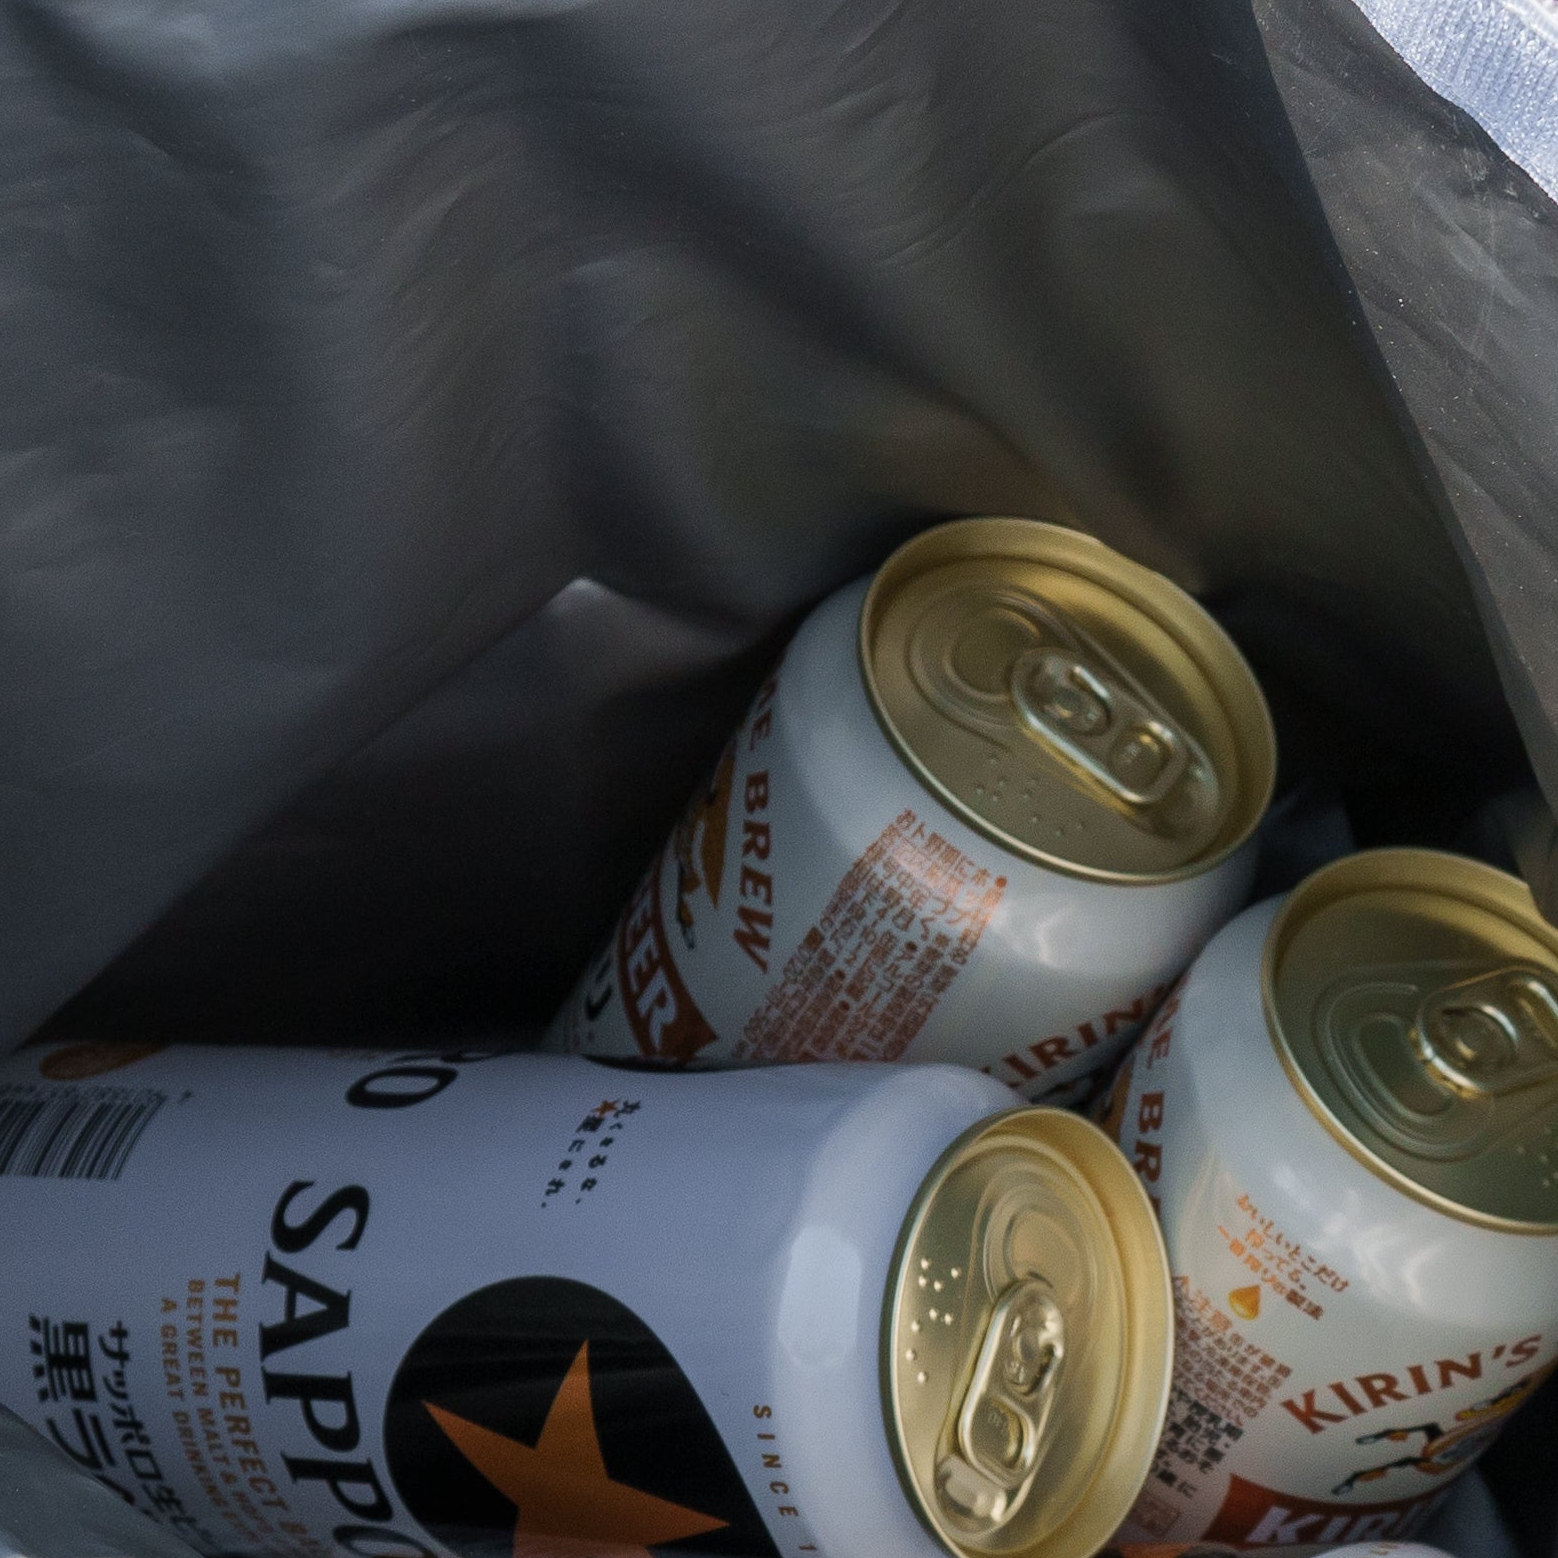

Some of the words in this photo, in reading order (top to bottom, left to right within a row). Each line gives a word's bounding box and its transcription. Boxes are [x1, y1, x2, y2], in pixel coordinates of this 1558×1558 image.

[733, 770, 774, 974] BREW
[160, 1297, 178, 1313] A
[186, 1278, 210, 1398] BETWEEN
[212, 1272, 241, 1348] THE
[160, 1323, 185, 1402] GREAT
[1280, 1334, 1542, 1435] KIRIN'S
[196, 1407, 231, 1466] MALT
[215, 1366, 289, 1513] PERFECT
[753, 1404, 799, 1517] SINCE
